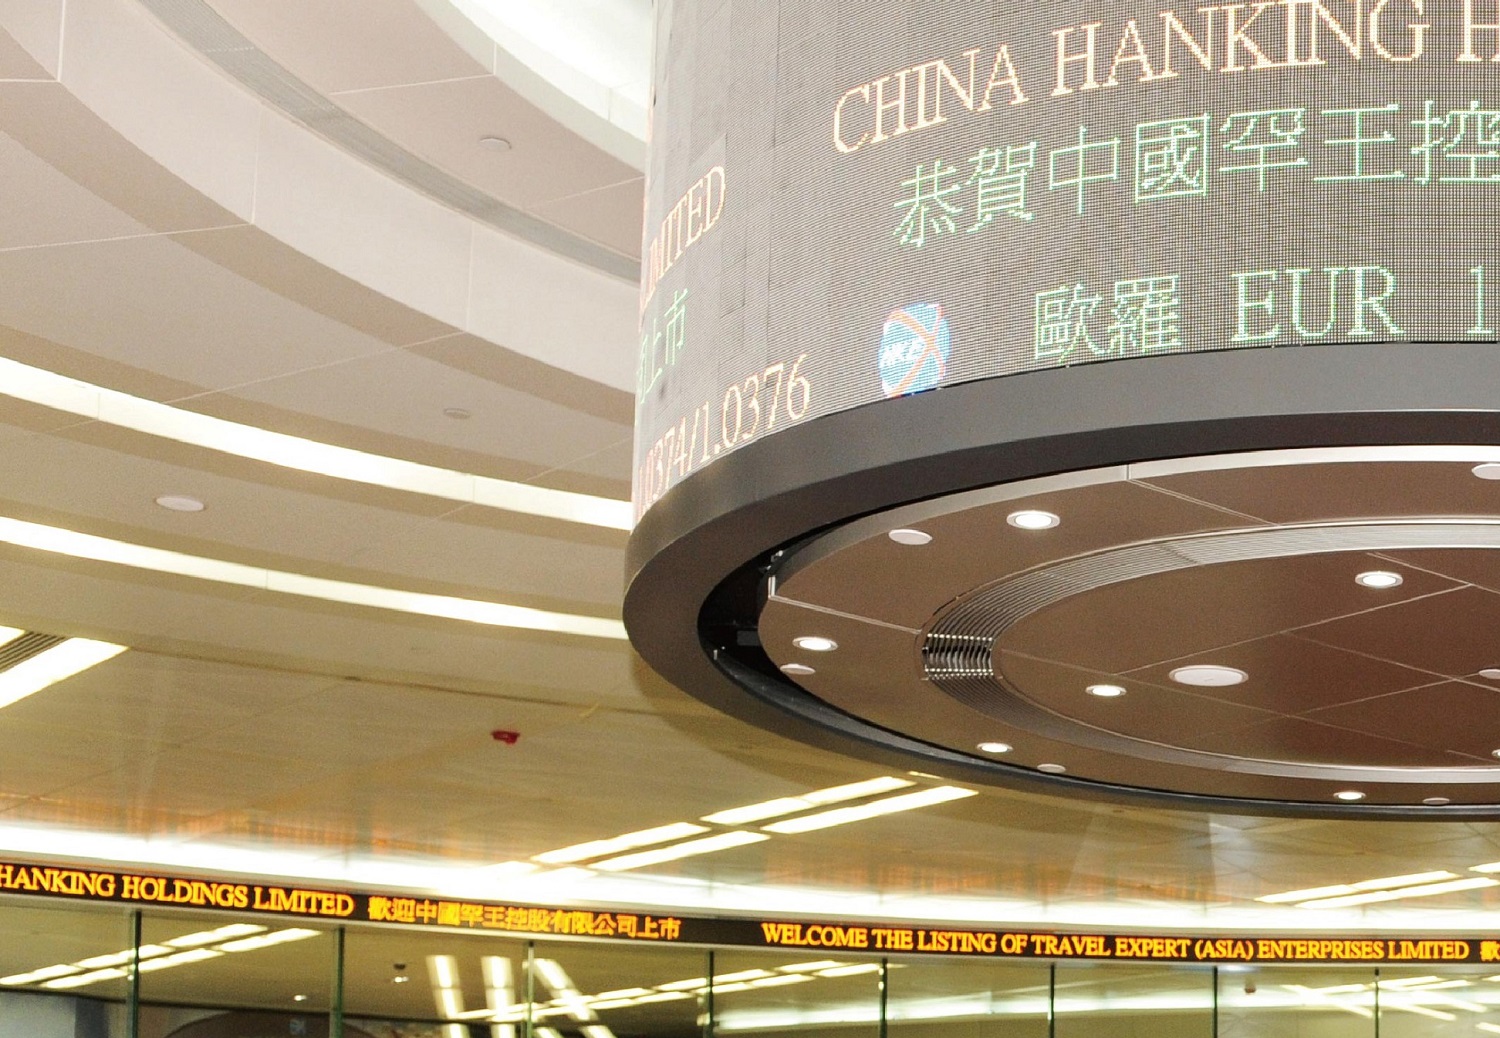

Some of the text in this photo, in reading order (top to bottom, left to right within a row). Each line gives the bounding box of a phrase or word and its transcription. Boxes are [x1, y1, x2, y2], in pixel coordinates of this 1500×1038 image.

[834, 45, 1029, 153] CHINA
[1051, 0, 1430, 96] HANKING
[1035, 274, 1182, 363] 歐羅
[1232, 265, 1405, 342] EUR
[0, 864, 354, 916] HANKING HOLDINGS LIMITED
[761, 922, 1470, 960] WELCOME THE LISTING OF TRAVEL EXPERT (ASIA) ENTERPRISES LIMITED
